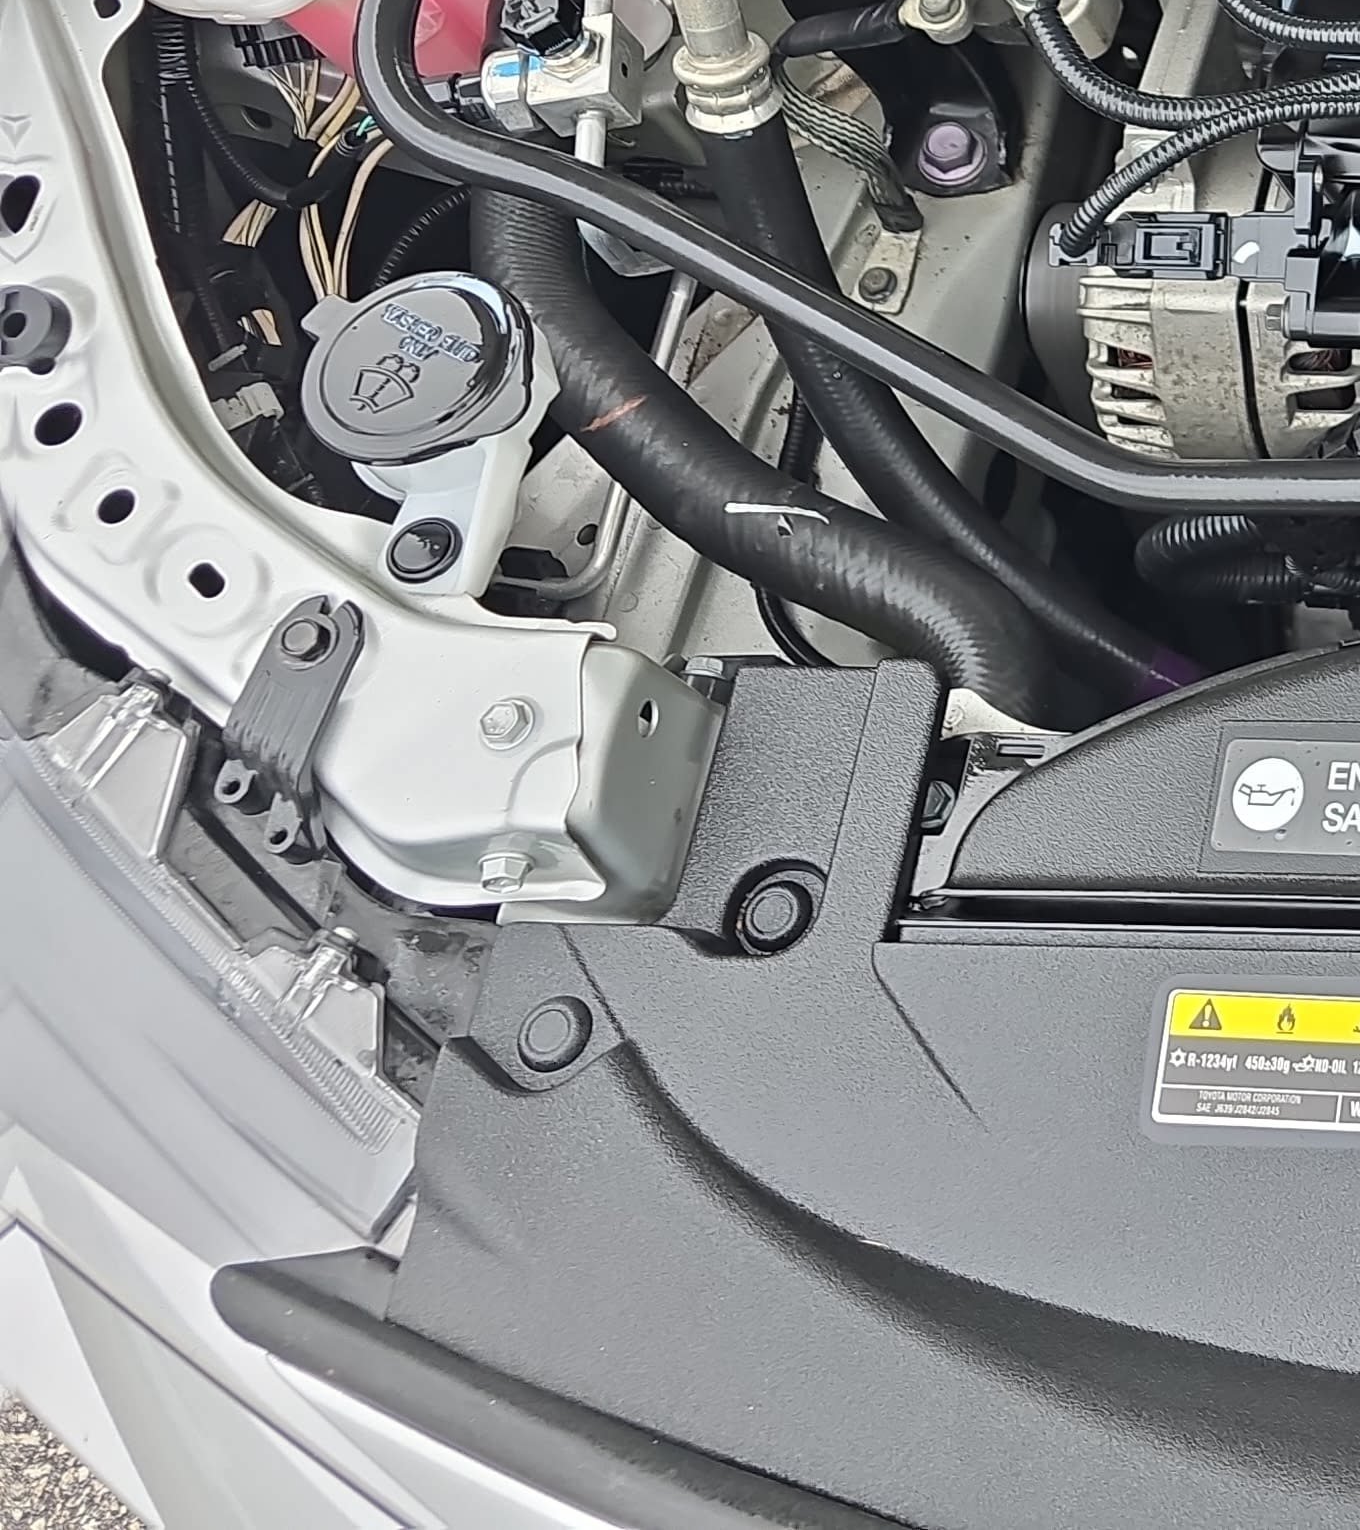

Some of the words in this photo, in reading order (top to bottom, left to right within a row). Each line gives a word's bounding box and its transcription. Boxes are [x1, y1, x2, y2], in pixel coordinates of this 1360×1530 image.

[1186, 1052, 1238, 1072] R-1234yf
[1244, 1055, 1291, 1075] 450±30g
[1314, 1057, 1348, 1075] ND-OIL
[1198, 1090, 1226, 1102] TOYOTA
[1226, 1091, 1252, 1103] MOTOR
[1252, 1092, 1302, 1105] CORPORATION
[1195, 1102, 1212, 1113] SAE
